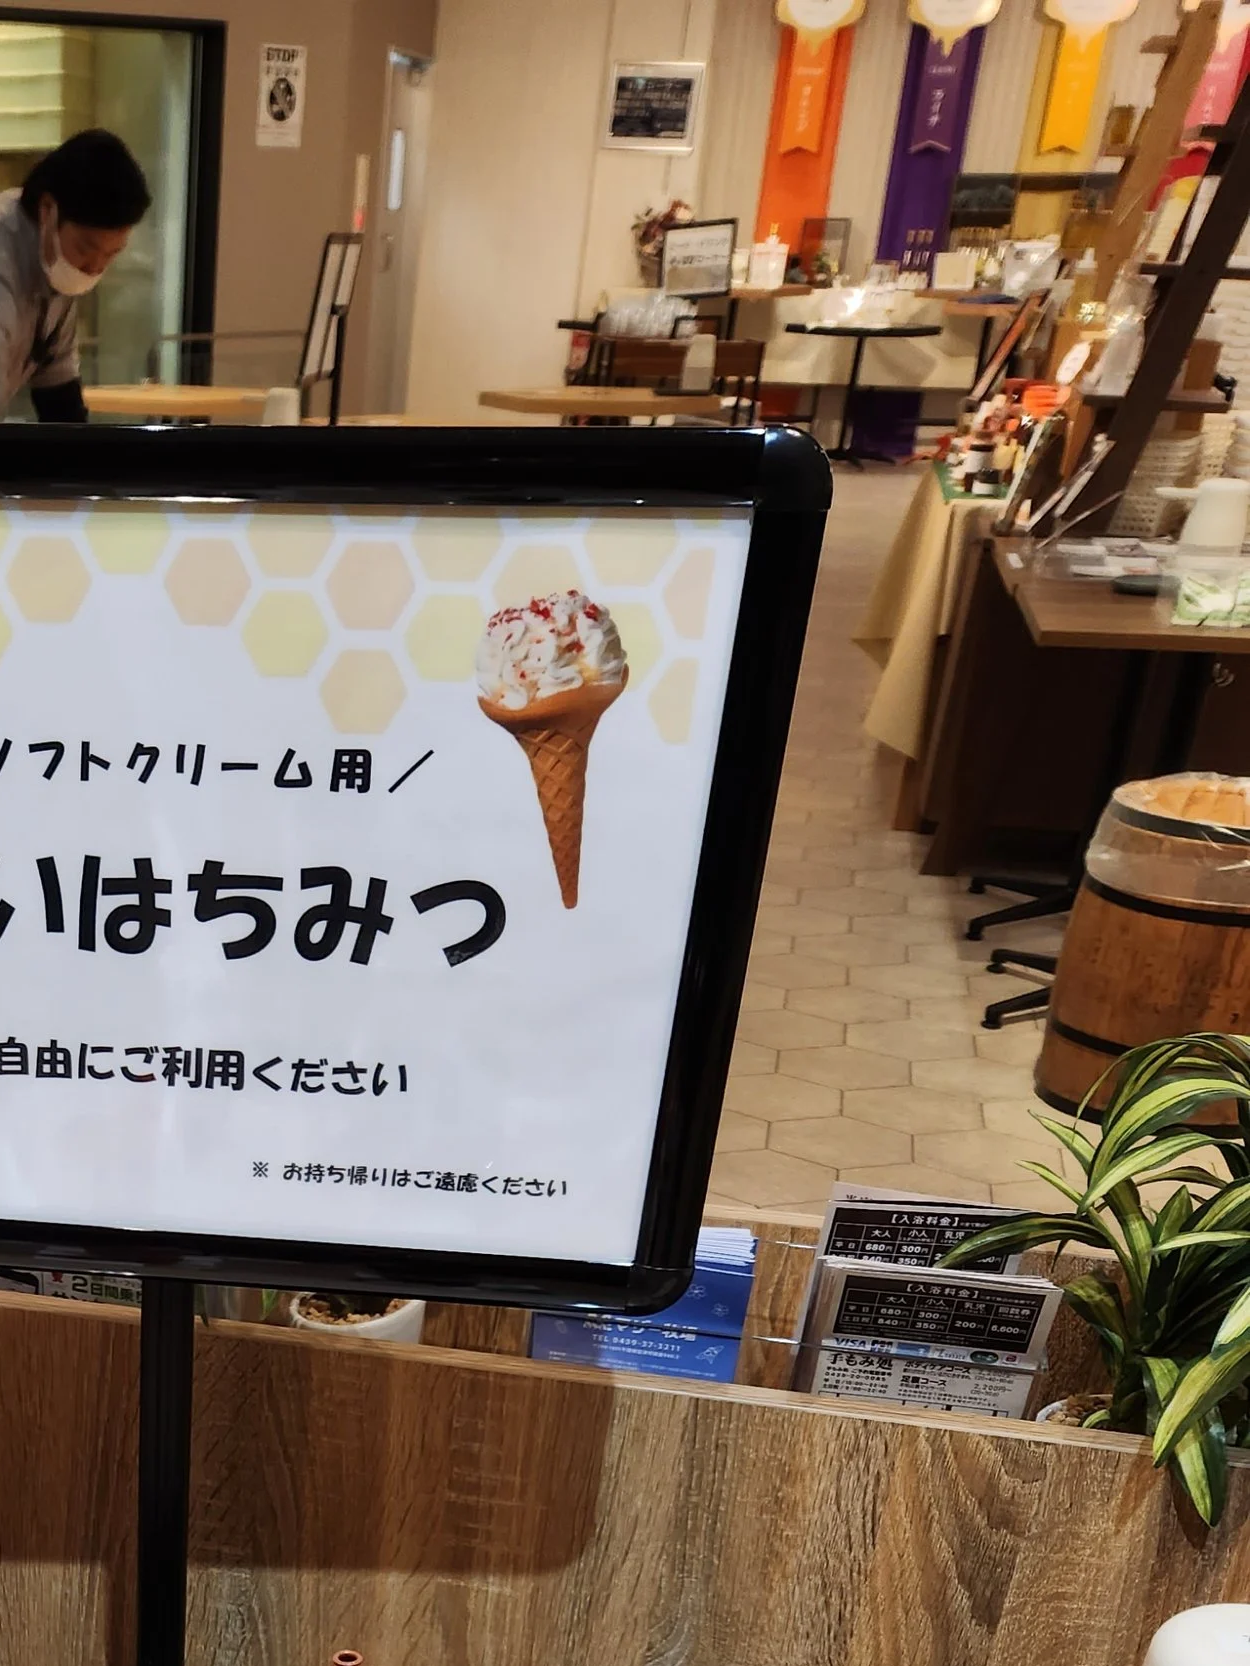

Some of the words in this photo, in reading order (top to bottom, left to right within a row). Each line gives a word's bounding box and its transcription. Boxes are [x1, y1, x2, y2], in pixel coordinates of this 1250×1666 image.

[282, 1162, 568, 1197] お持ち帰りはご遠慮ください
[834, 1337, 867, 1349] VISA
